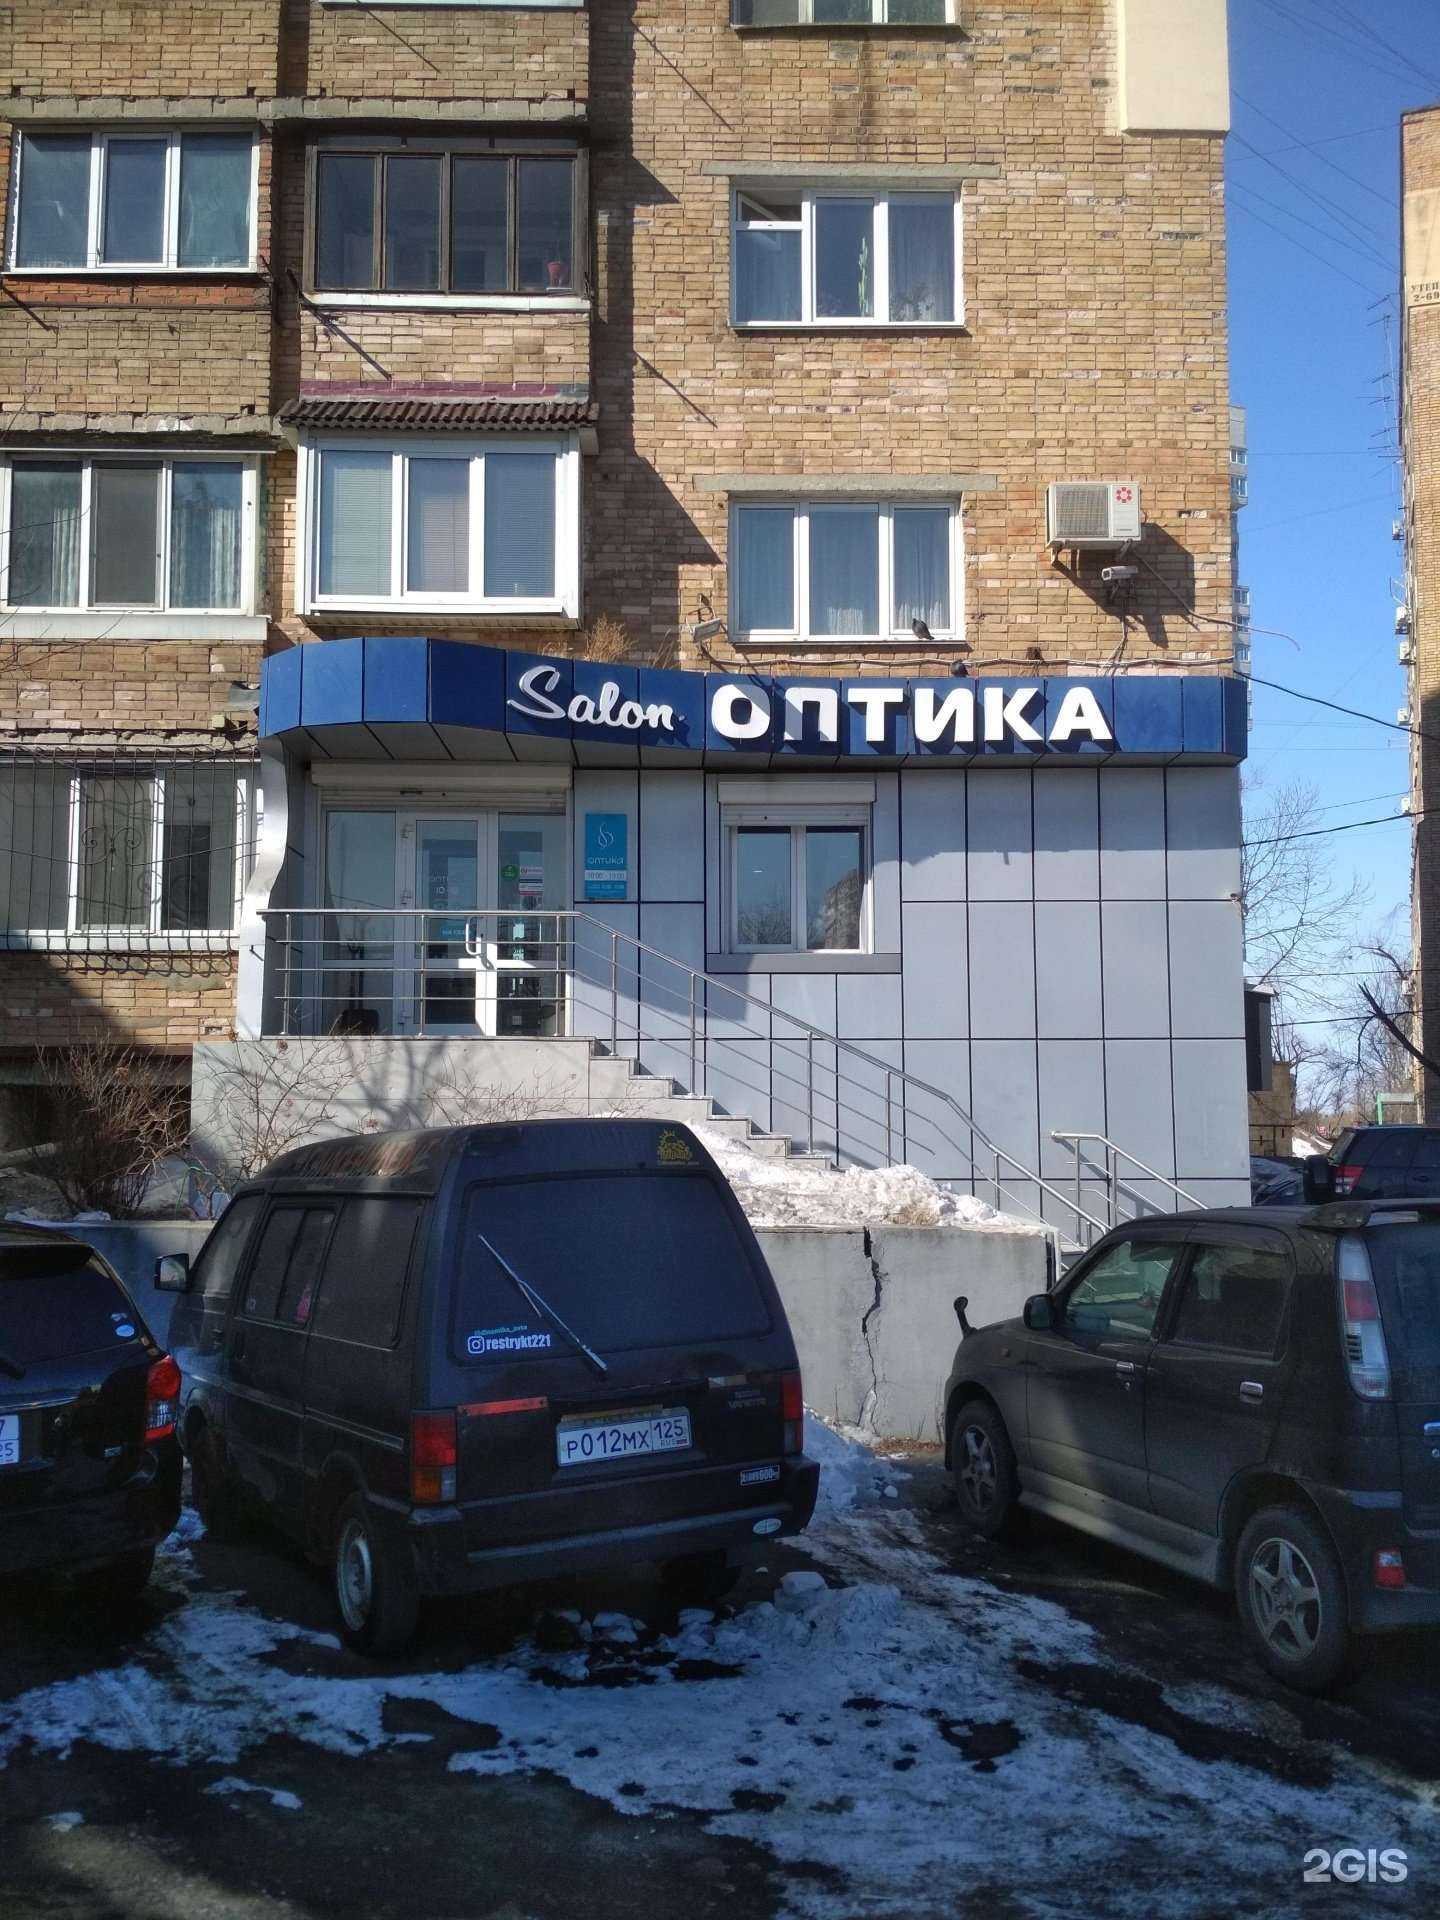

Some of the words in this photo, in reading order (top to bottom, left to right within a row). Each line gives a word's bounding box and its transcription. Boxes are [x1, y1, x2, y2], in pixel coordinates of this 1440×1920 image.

[507, 665, 674, 731] Salon
[711, 684, 1112, 743] ОПТИКА
[486, 1334, 550, 1349] restrykt221
[653, 1420, 683, 1439] 125
